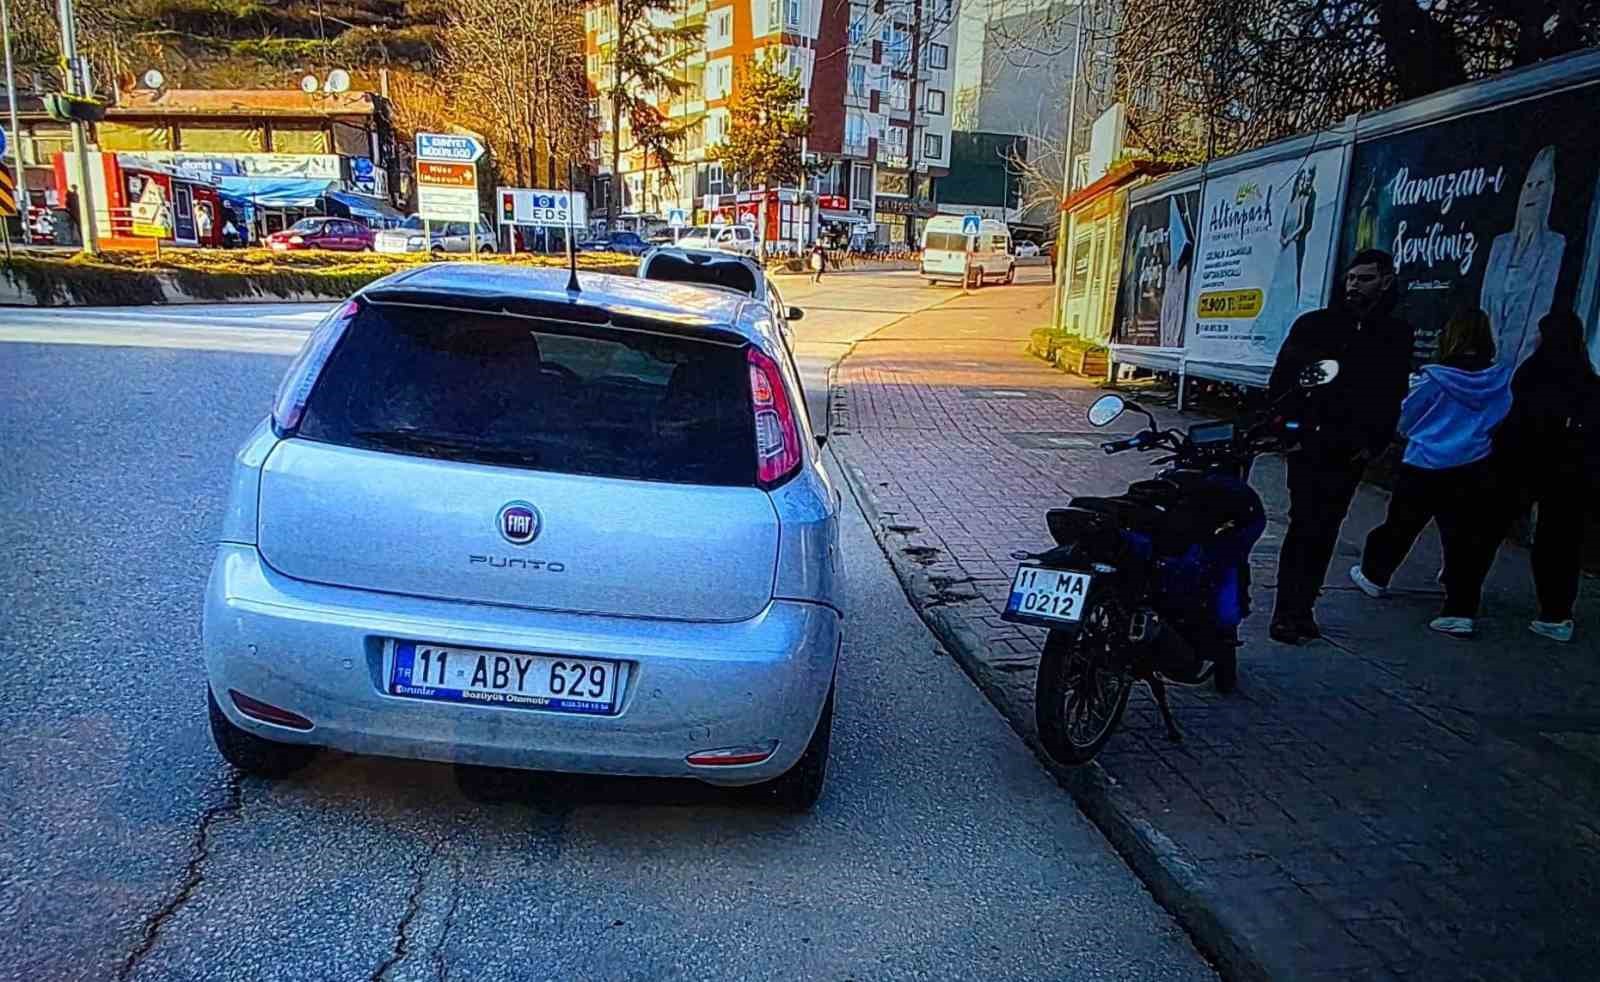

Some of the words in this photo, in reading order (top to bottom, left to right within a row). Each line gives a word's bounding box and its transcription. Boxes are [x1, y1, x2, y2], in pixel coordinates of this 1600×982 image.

[532, 208, 568, 221] EDS
[507, 514, 531, 534] FIAT
[469, 554, 566, 573] PUNTO
[1020, 570, 1037, 588] 11
[1056, 574, 1083, 596] MA
[1025, 593, 1074, 616] 0212
[397, 667, 411, 678] TR
[419, 649, 448, 684] 11
[470, 654, 532, 692] ABY
[549, 661, 606, 698] 629
[506, 694, 551, 705] Otomotiv
